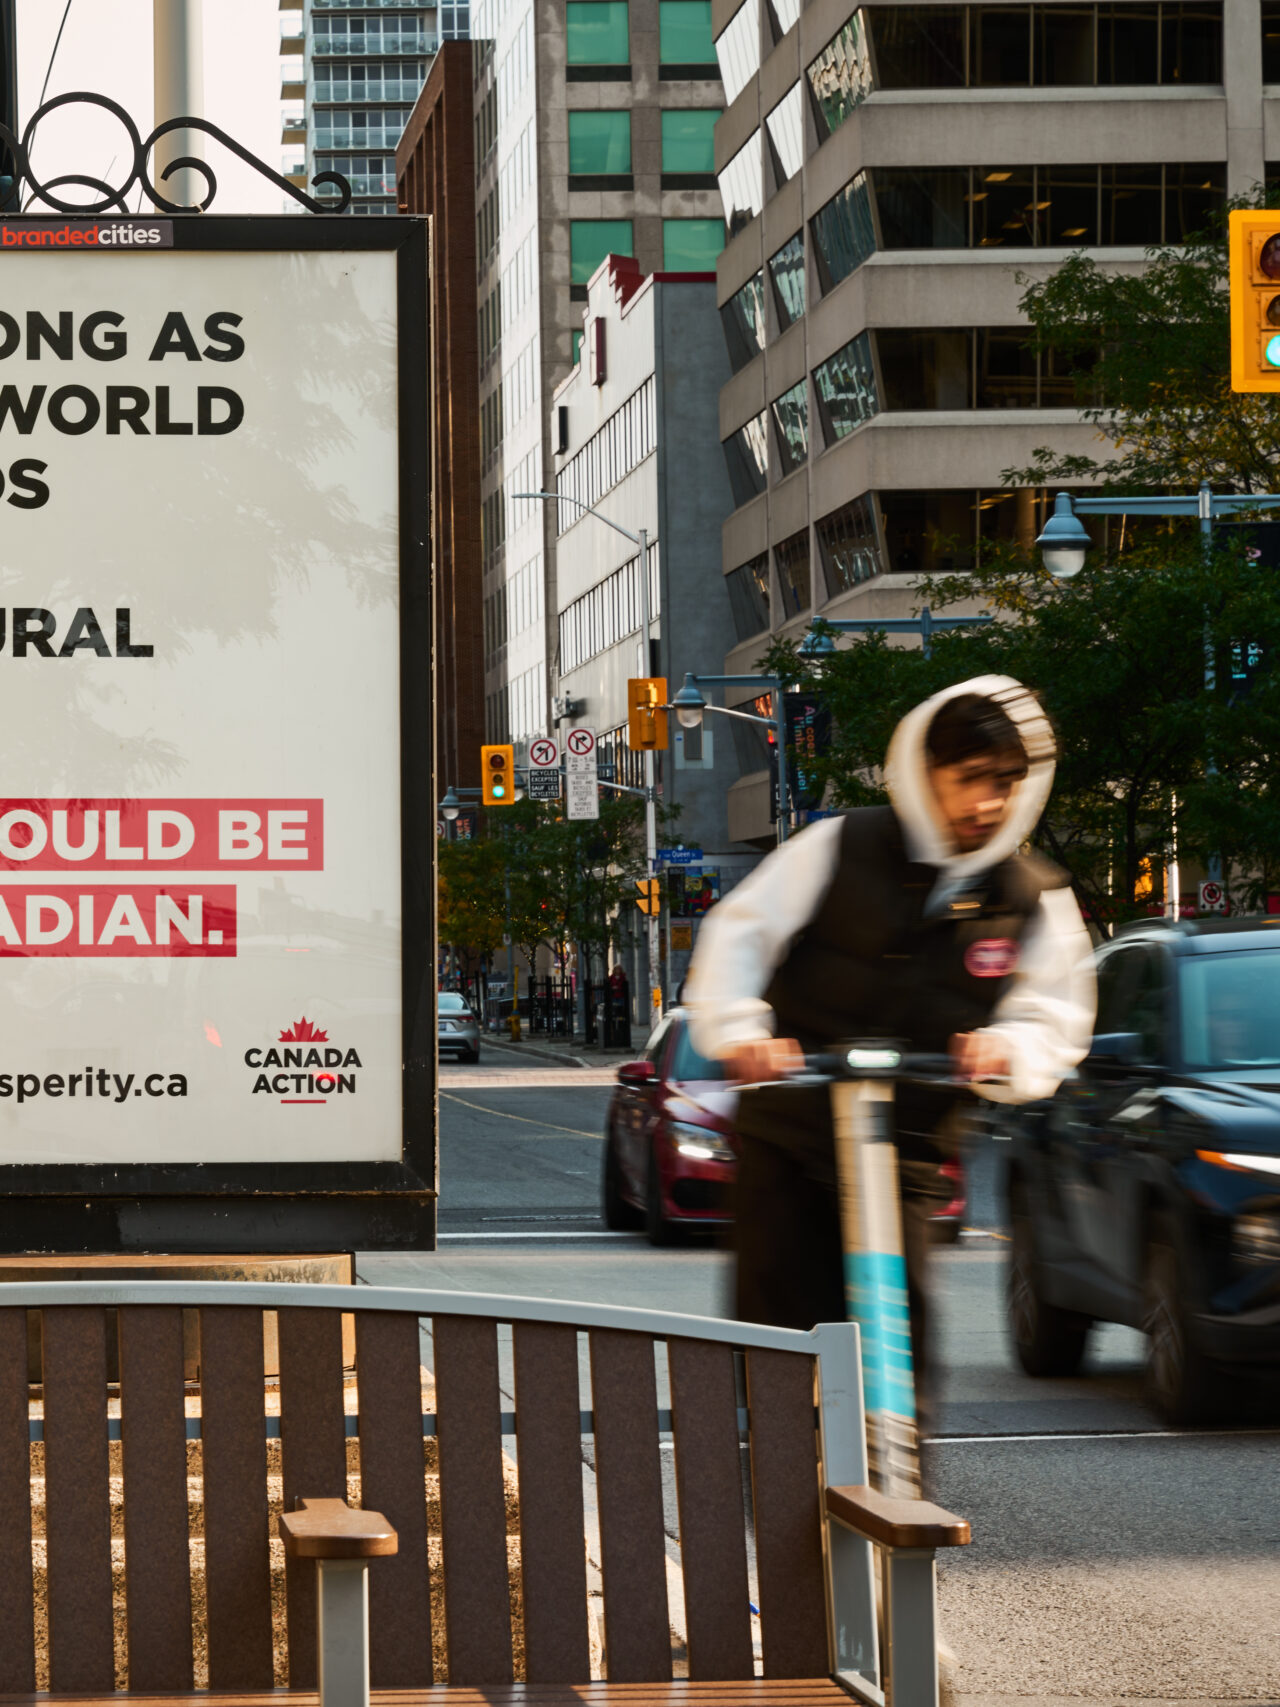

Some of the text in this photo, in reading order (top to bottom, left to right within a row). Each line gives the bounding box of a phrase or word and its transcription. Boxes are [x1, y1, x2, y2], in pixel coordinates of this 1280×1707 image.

[2, 224, 161, 246] brandedcities
[149, 312, 245, 362] AS
[805, 705, 816, 724] Au
[218, 811, 309, 860] BE
[672, 850, 690, 858] Queen
[244, 1048, 363, 1068] CANADA
[252, 1073, 356, 1094] ACTION
